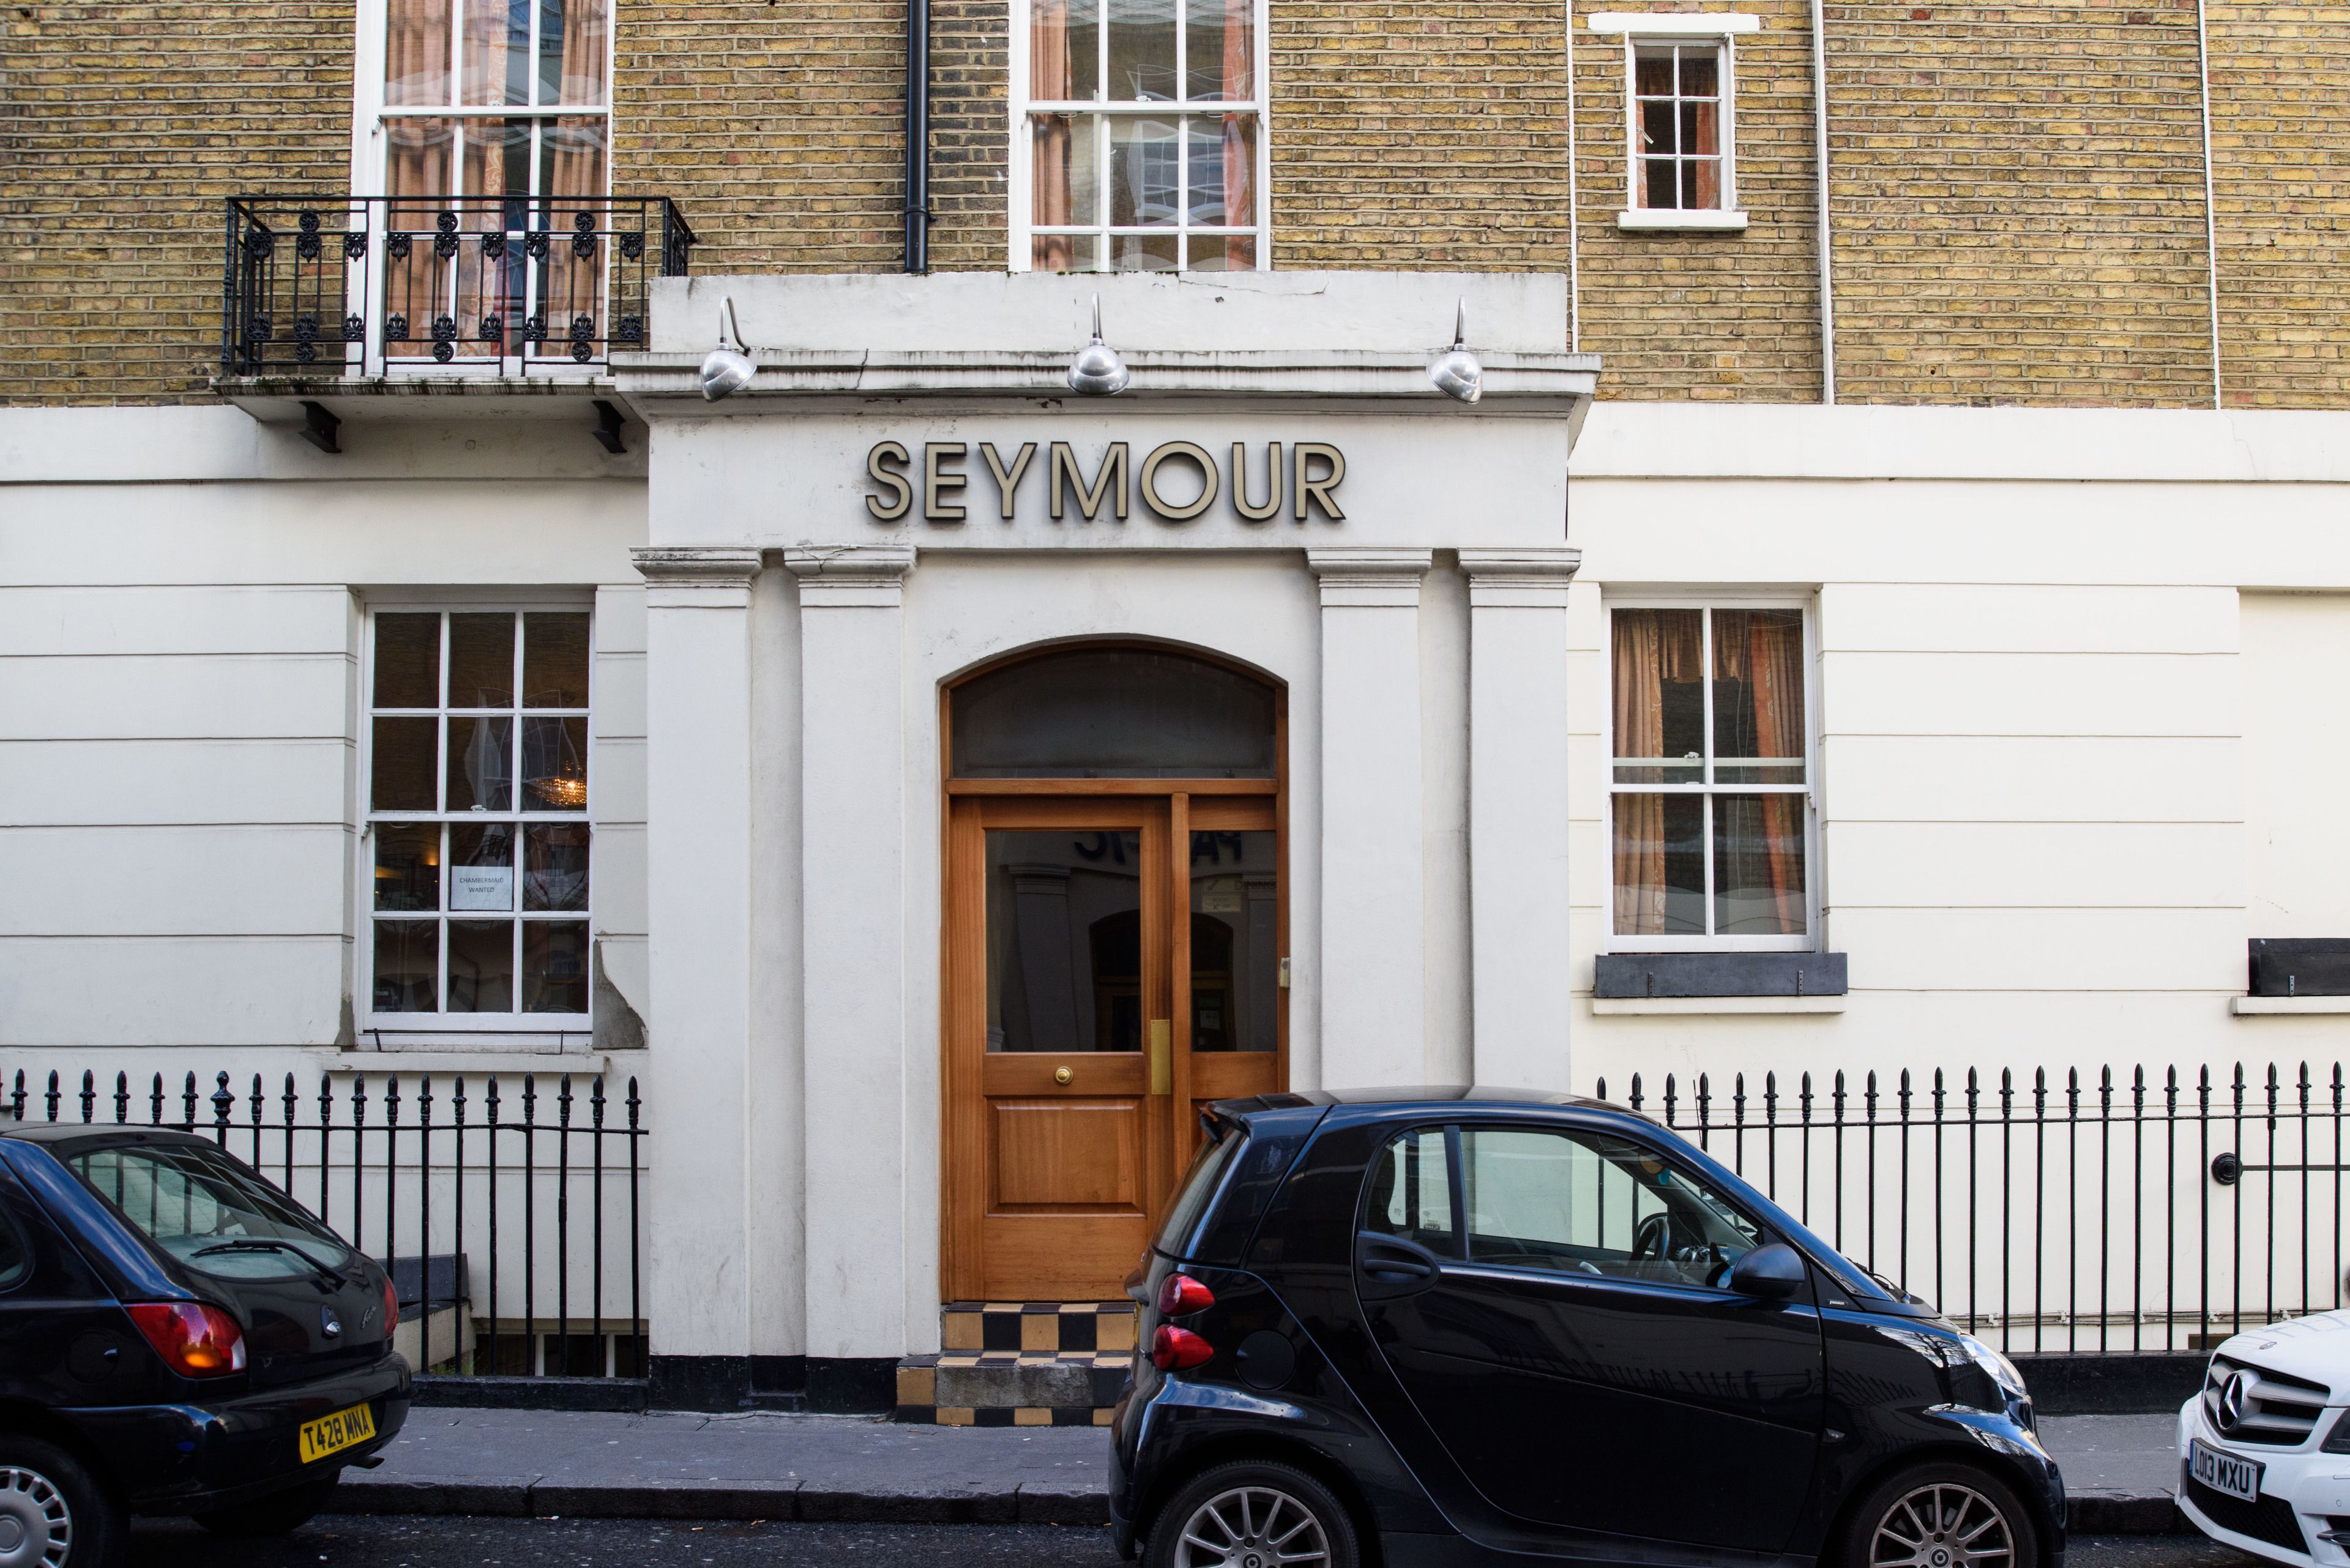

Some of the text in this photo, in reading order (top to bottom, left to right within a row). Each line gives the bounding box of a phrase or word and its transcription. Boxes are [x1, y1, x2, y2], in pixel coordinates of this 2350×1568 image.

[865, 440, 1347, 521] SEYMOUR
[304, 1408, 370, 1455] T428 MNA
[2195, 1446, 2250, 1493] LO13 MXU
